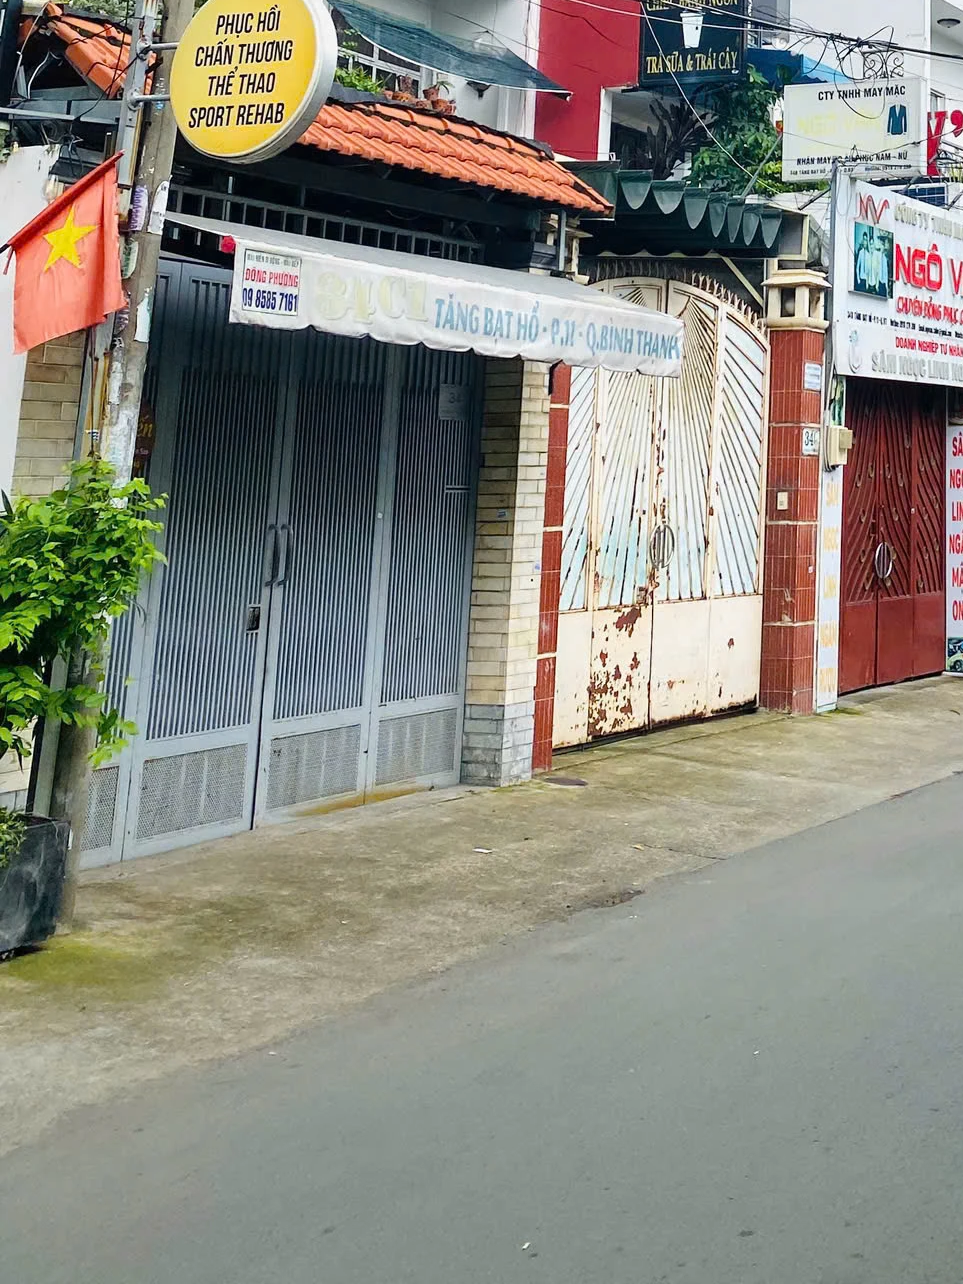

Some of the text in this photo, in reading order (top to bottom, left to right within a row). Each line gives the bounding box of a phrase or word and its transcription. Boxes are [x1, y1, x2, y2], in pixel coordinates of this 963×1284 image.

[216, 5, 281, 38] PHỤC HỒI
[195, 38, 293, 67] CHẤN THƯƠNG
[686, 54, 694, 72] &
[695, 47, 717, 71] TRÁI
[718, 46, 738, 69] CÂY
[208, 66, 276, 96] THỂ THAO
[818, 84, 906, 101] CTY TNHH MAY MẶC
[188, 103, 285, 128] SPORT REHAB
[895, 243, 943, 292] NGÔ
[242, 287, 298, 313] 09 8585 7161
[434, 293, 480, 335] TĂNG
[516, 300, 541, 343] HỔ
[895, 336, 917, 349] DOANH
